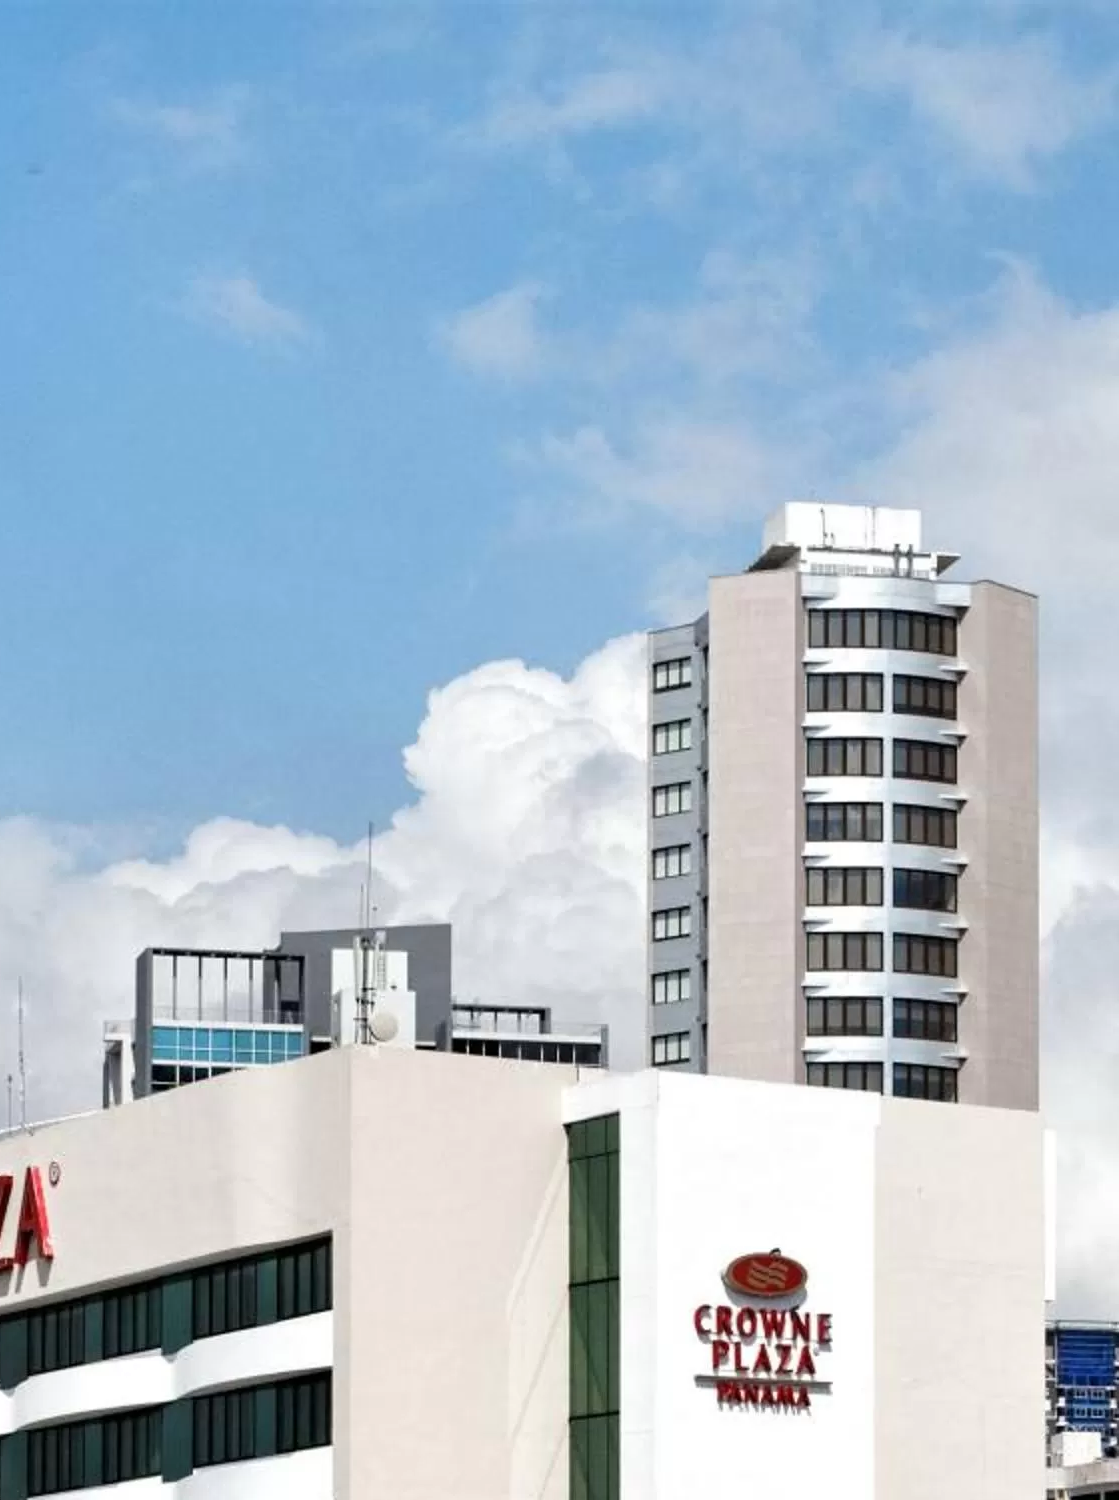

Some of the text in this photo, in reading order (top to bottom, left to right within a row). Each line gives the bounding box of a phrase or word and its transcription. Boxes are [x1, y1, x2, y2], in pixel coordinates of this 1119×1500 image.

[694, 1304, 833, 1344] CROWNE
[712, 1339, 816, 1375] PLAZA
[716, 1381, 811, 1407] PANAMA
